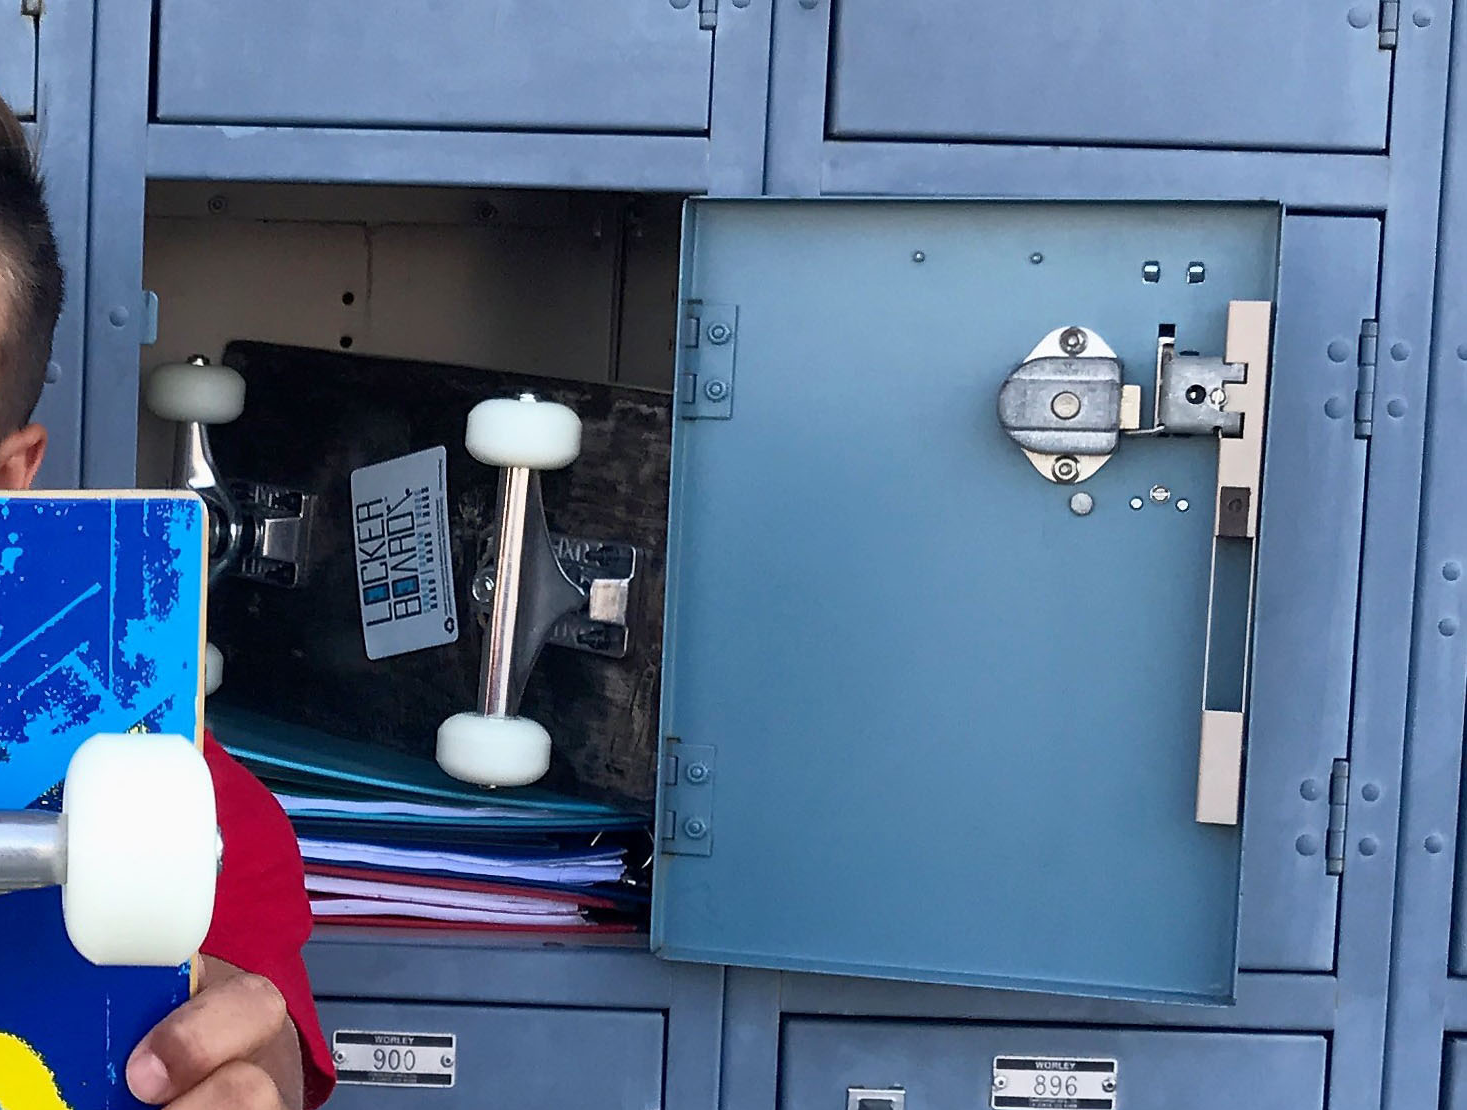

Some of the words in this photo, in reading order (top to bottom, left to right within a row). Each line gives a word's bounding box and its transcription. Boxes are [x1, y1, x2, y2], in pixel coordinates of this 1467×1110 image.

[356, 497, 392, 626] LOCKER
[387, 510, 422, 620] BOARD
[373, 1035, 415, 1045] WORLEY
[373, 1048, 416, 1071] 900
[1035, 1061, 1076, 1070] WORLEY
[1033, 1074, 1078, 1096] 896
